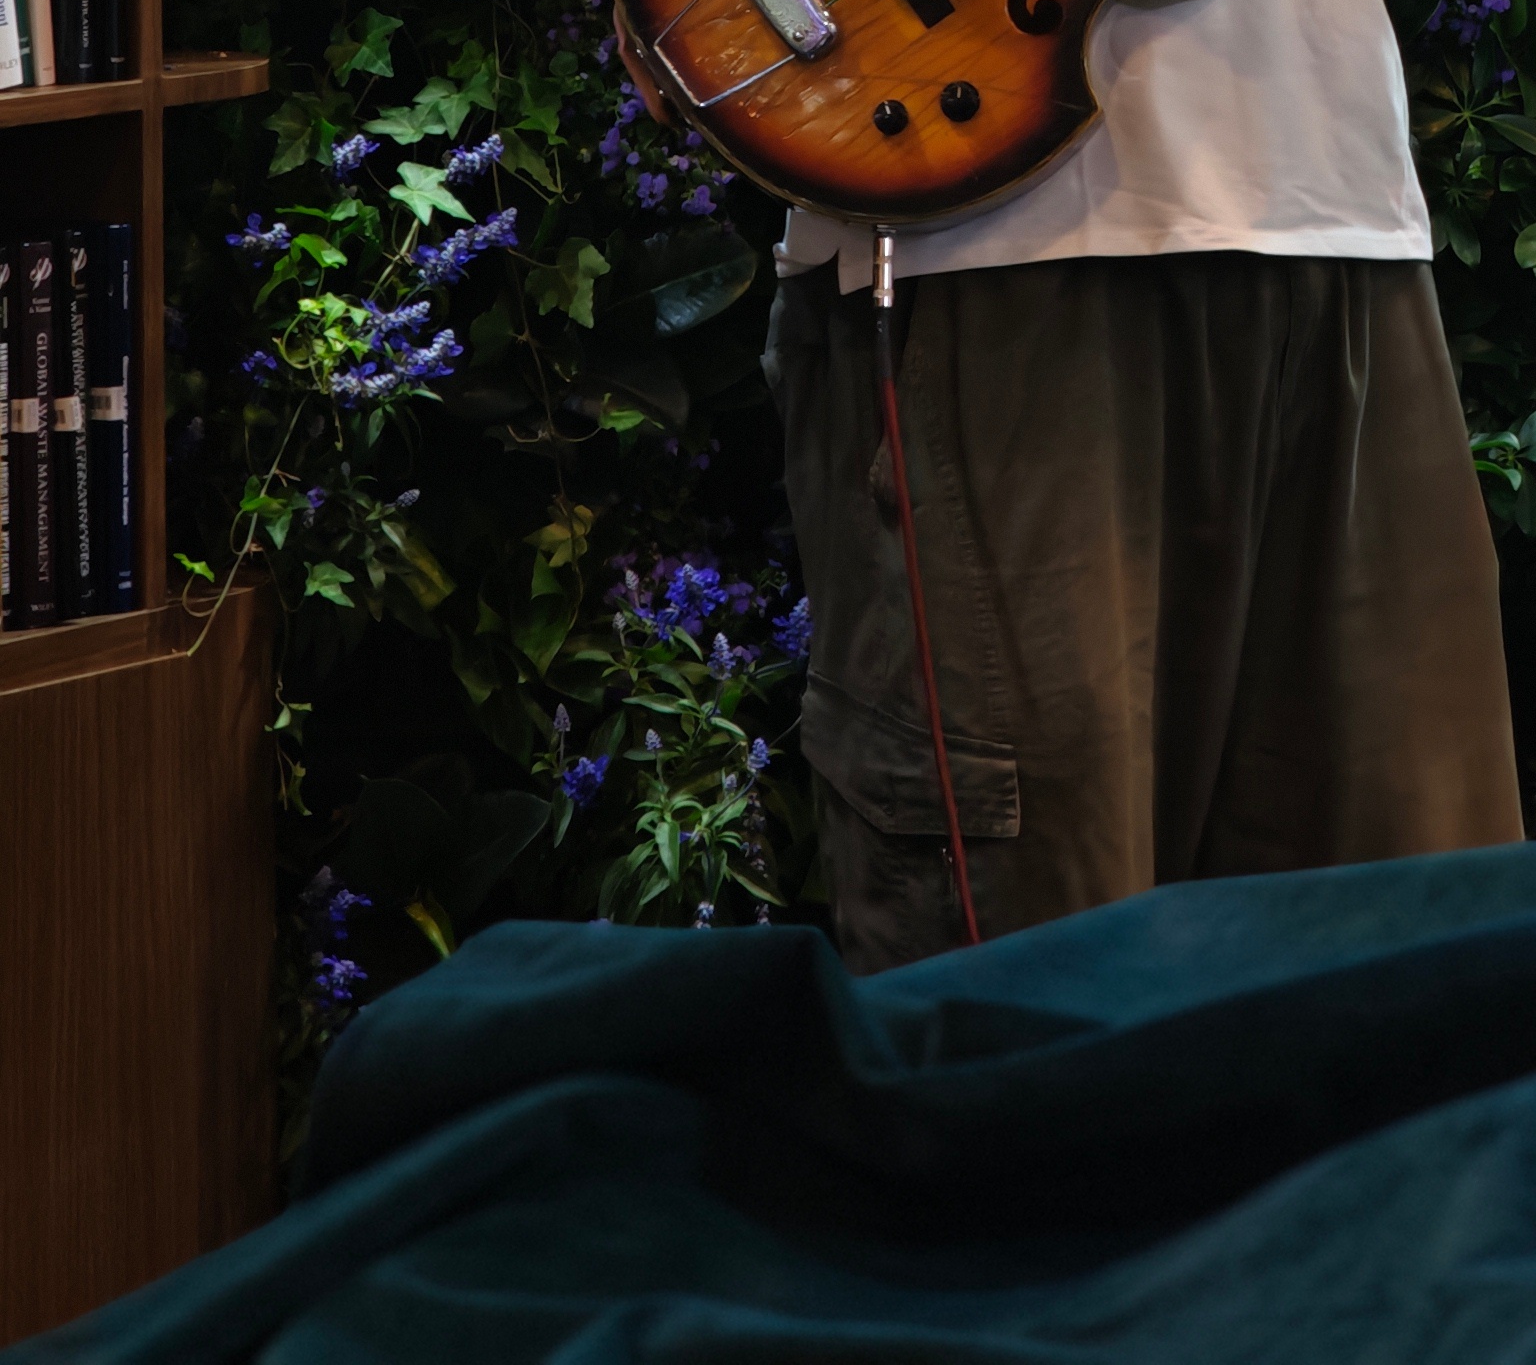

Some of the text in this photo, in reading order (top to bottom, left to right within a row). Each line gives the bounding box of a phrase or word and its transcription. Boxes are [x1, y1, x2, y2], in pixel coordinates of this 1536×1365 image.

[36, 332, 50, 582] GLOBAL WASTE MANAGEMENT
